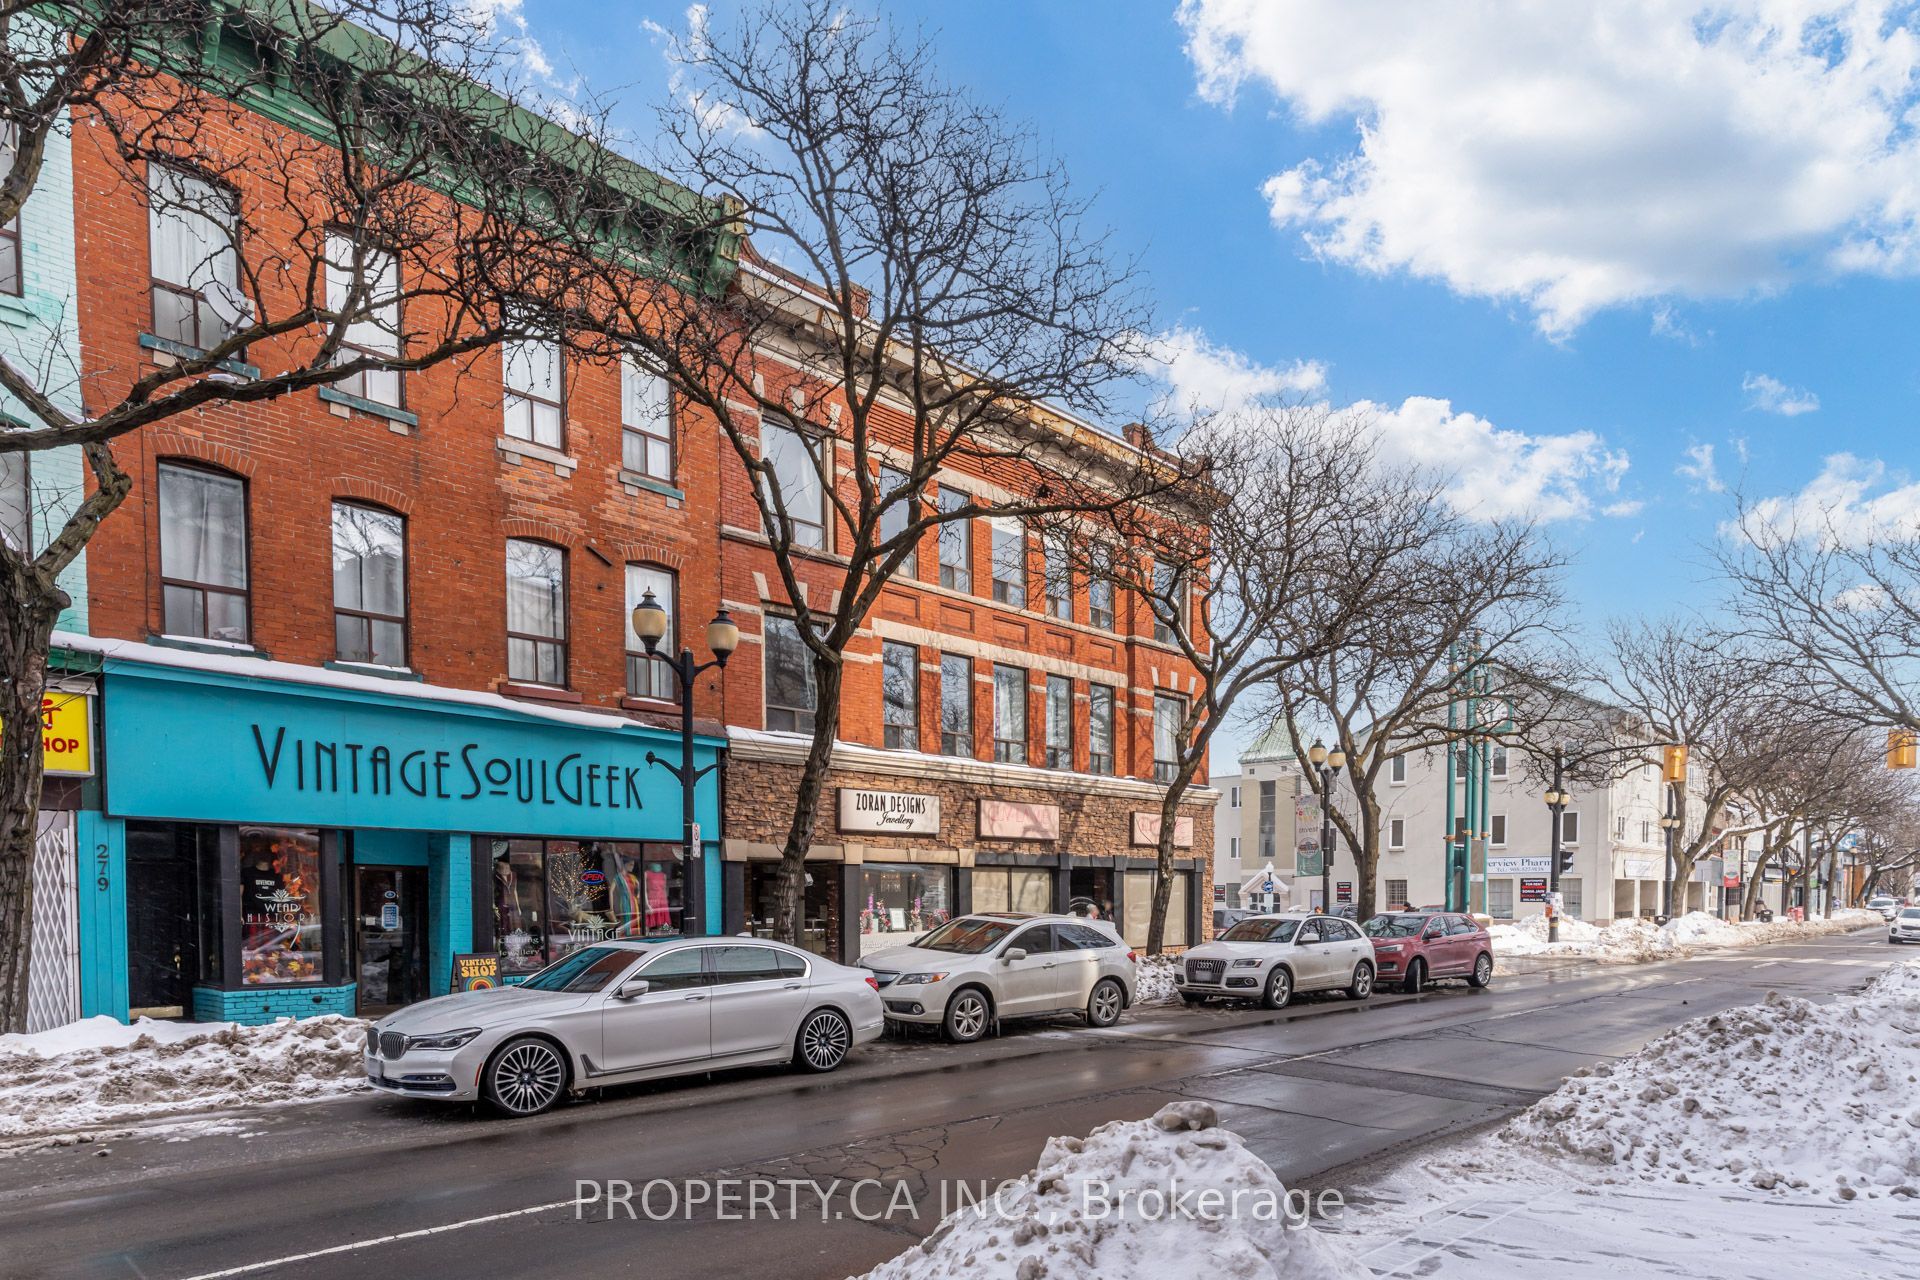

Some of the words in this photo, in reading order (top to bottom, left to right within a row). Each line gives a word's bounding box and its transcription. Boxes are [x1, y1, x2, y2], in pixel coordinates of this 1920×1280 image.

[43, 737, 79, 754] HOP
[856, 793, 886, 812] ZORAN
[890, 795, 926, 815] DESIGNS
[876, 810, 914, 830] Jewellery
[96, 844, 110, 892] 279
[580, 873, 605, 881] OPEN
[247, 913, 316, 923] HISTORY
[567, 928, 621, 942] VINTAGE
[459, 958, 496, 967] VINTAGE
[461, 965, 497, 978] SHOP
